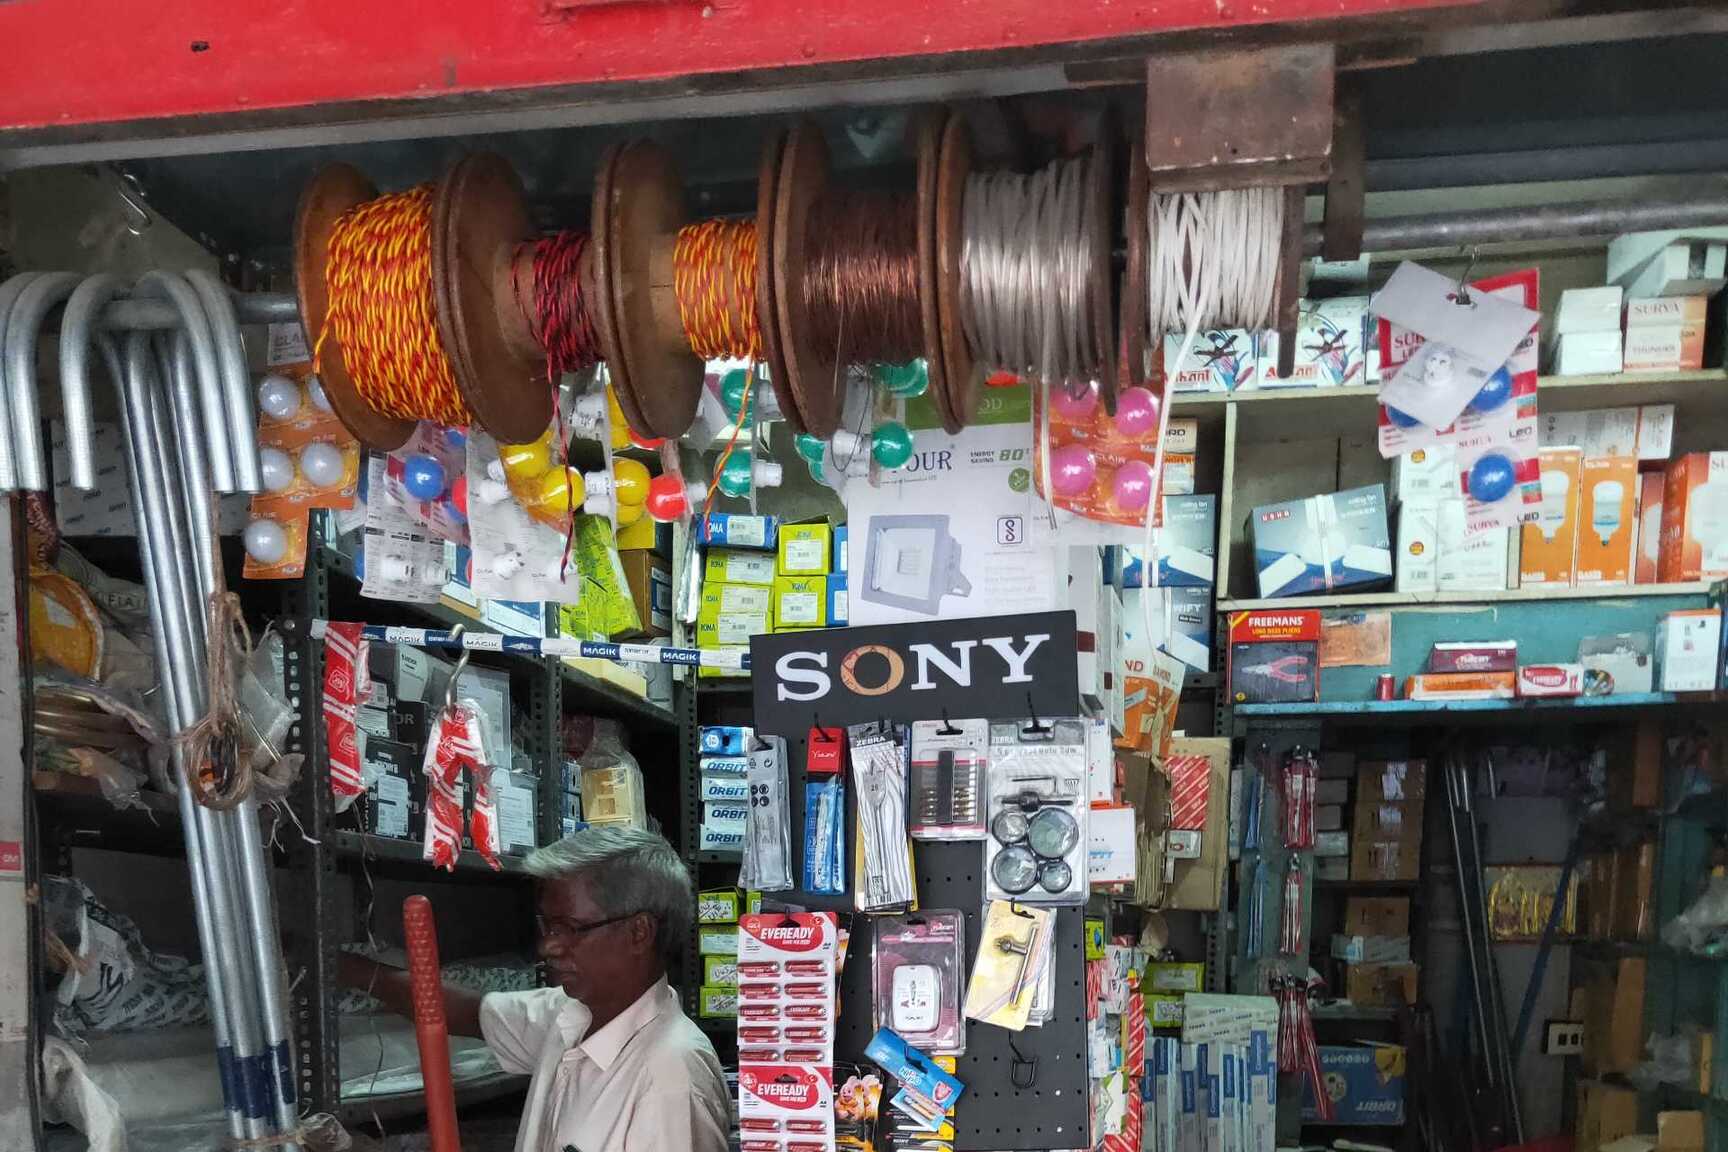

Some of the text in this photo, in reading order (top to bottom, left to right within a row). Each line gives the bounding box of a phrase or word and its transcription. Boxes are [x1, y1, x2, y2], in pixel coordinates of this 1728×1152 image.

[1248, 616, 1304, 627] FREEMANS
[583, 647, 616, 656] MAGIK
[663, 652, 697, 661] MAGIK
[773, 633, 1050, 702] SONY
[856, 736, 886, 747] ZEBRA
[707, 761, 747, 773] ORBIT
[708, 786, 748, 796] ORBIT
[705, 833, 744, 843] ORBIT
[760, 927, 815, 940] EVEREADY
[757, 1083, 810, 1096] EVEREADY
